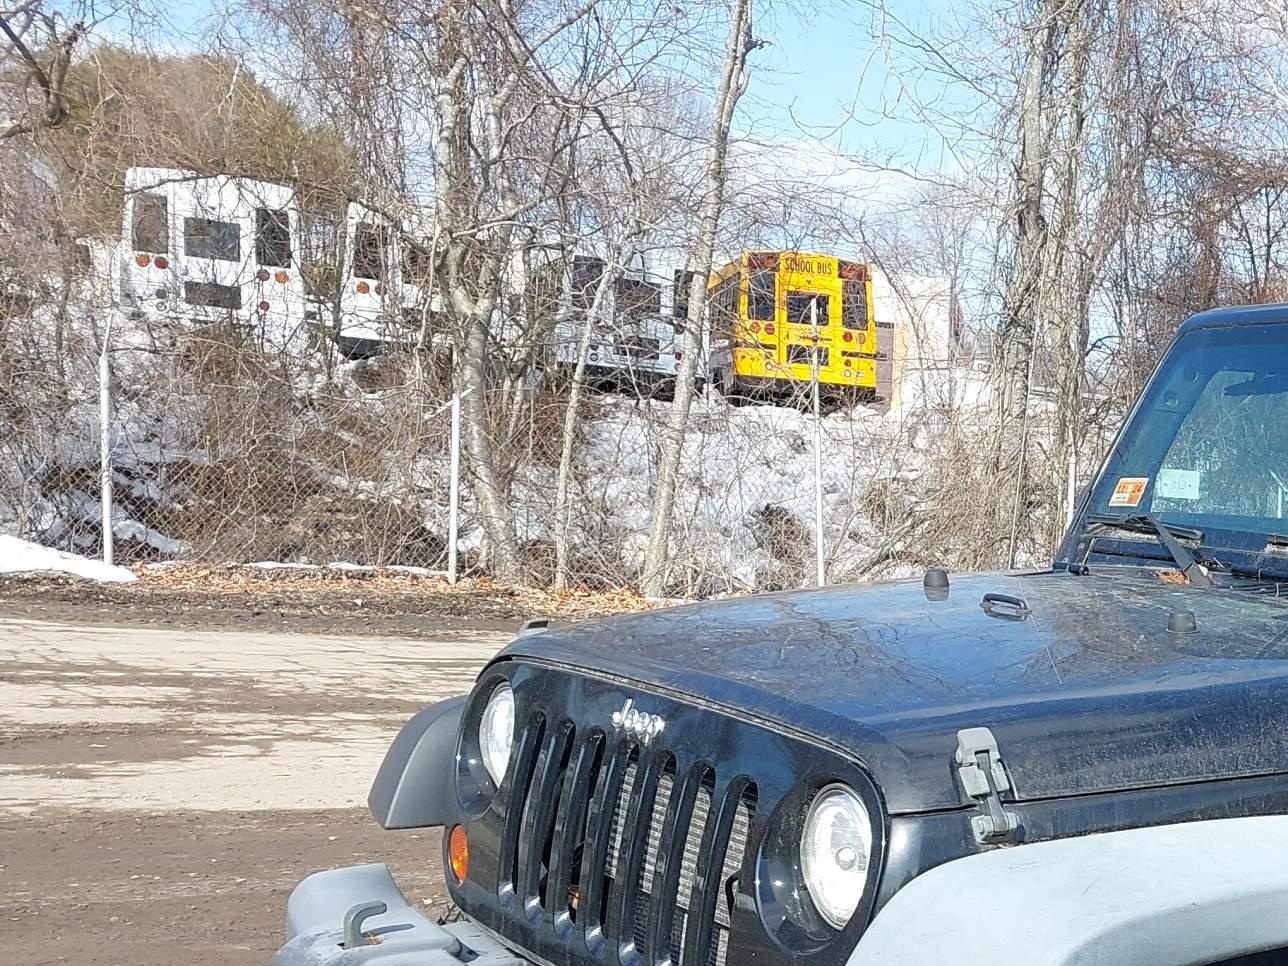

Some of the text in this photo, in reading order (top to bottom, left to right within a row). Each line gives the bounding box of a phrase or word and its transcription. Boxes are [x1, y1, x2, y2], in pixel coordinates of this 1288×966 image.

[784, 257, 832, 275] SCHOOL BUS
[609, 698, 665, 745] Jeep
